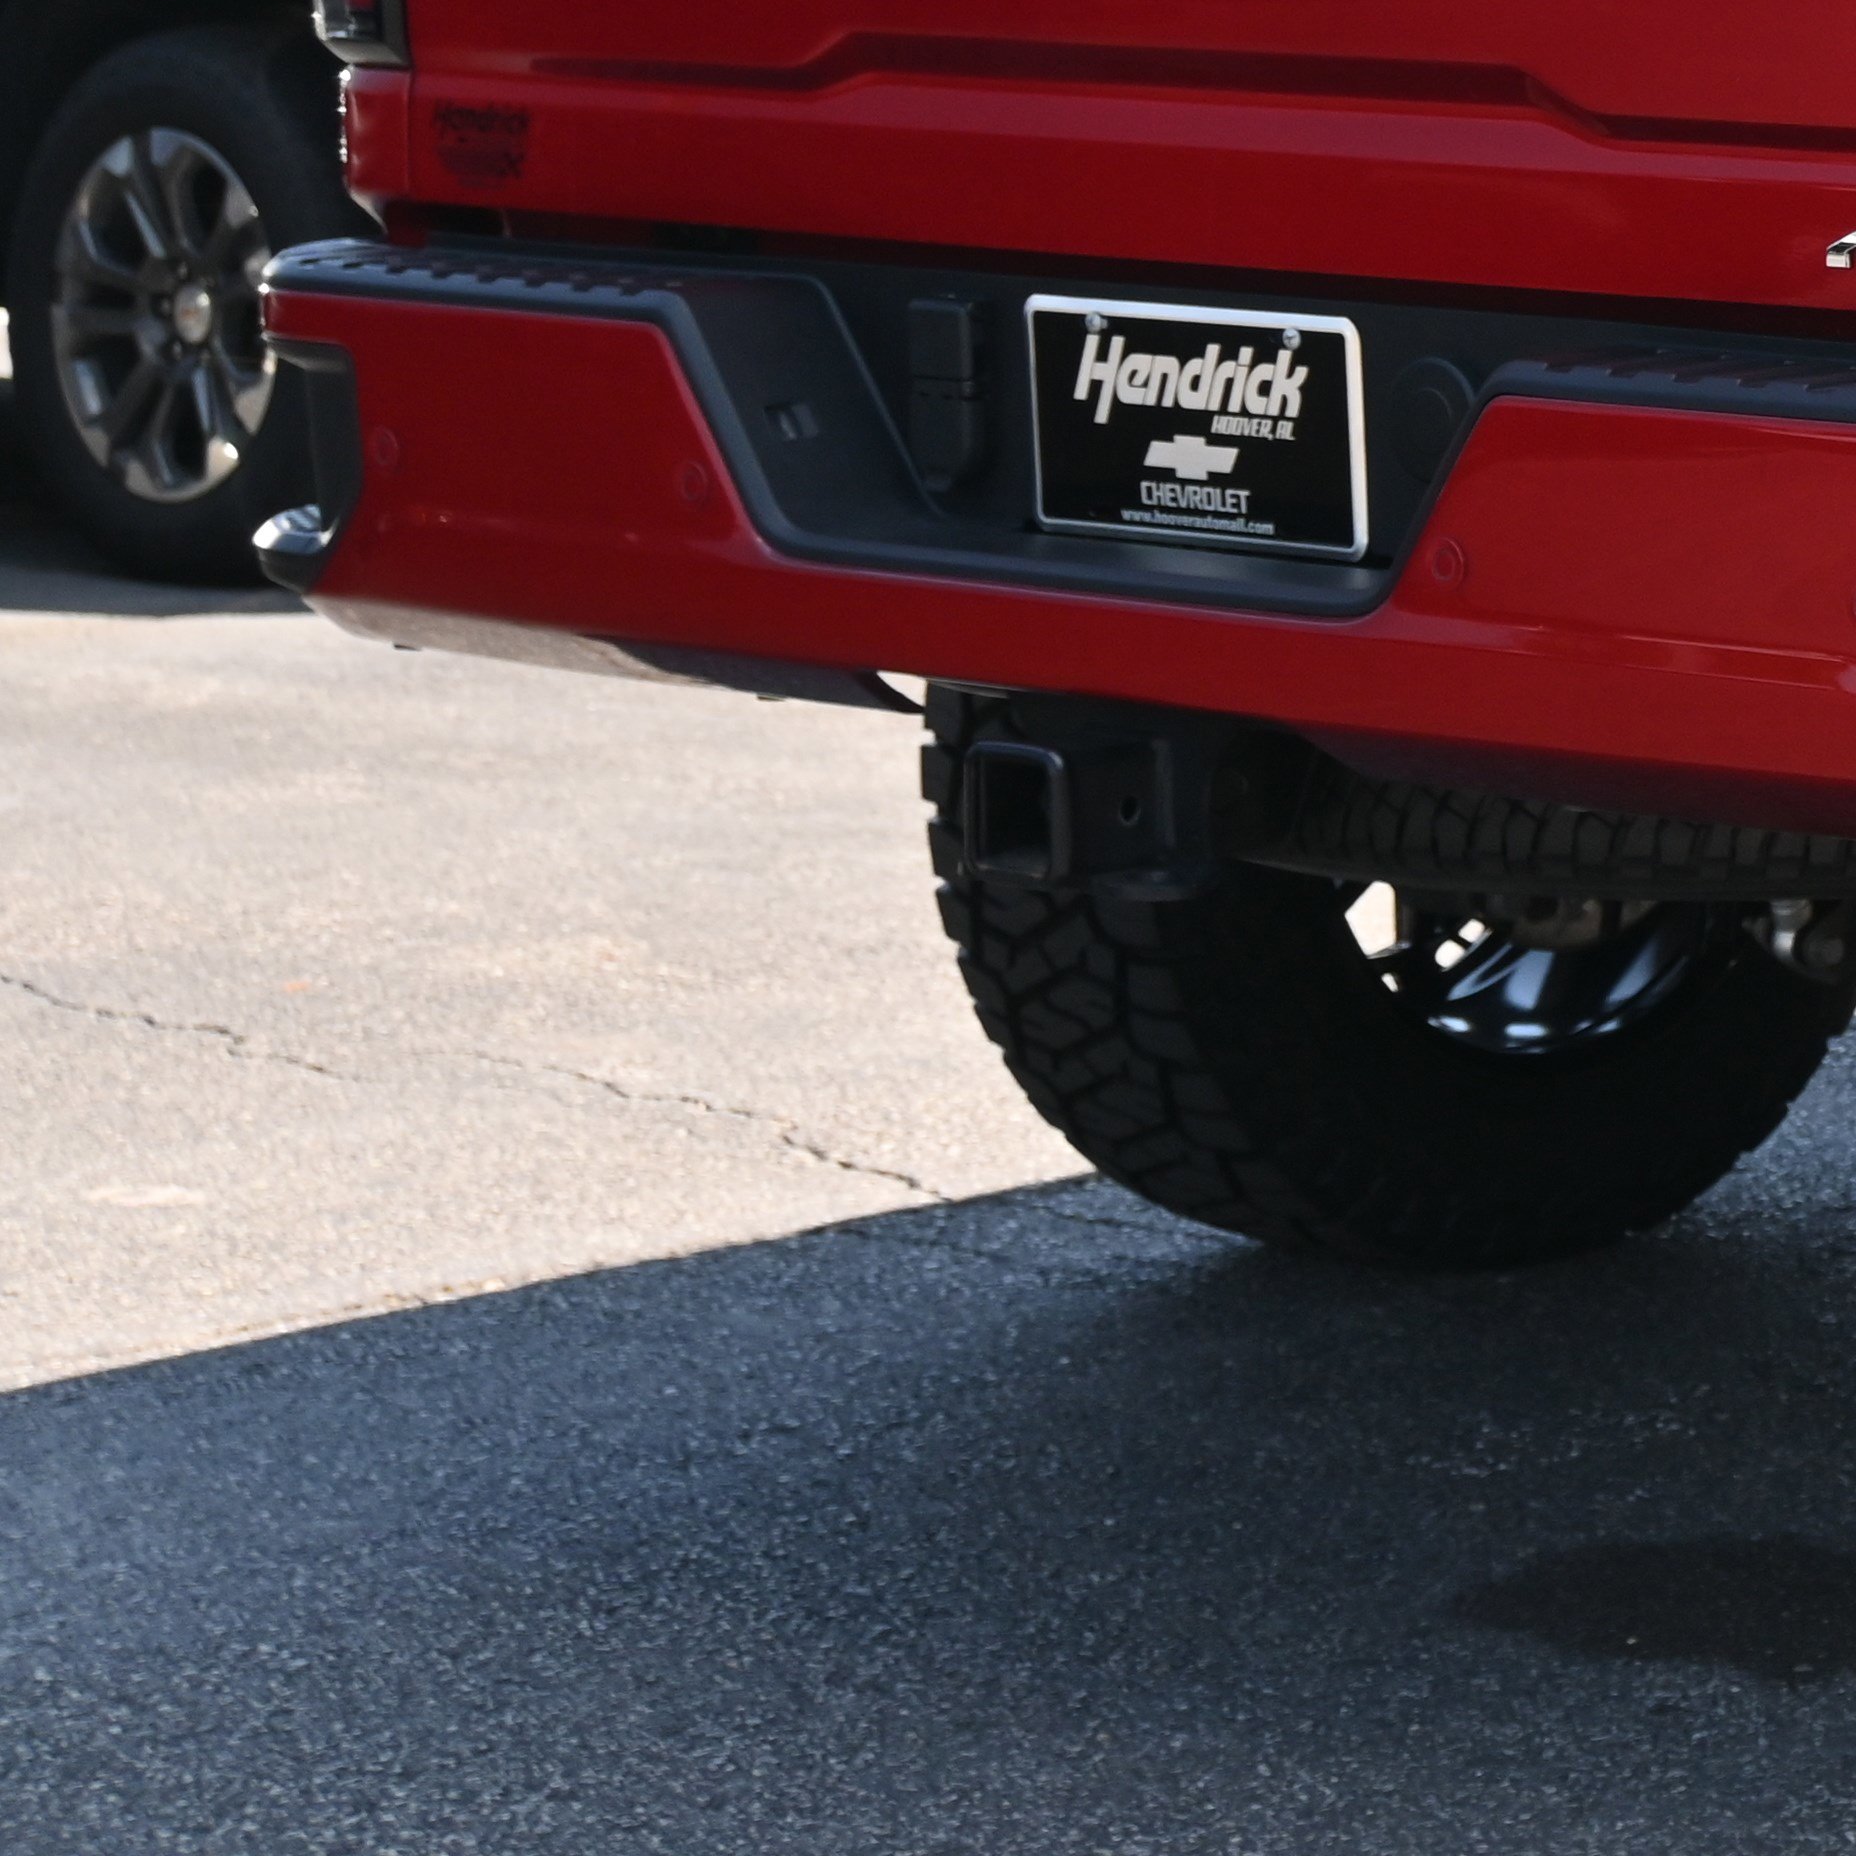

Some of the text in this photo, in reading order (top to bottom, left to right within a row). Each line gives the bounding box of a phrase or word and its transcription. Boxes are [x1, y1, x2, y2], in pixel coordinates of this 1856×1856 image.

[1073, 333, 1309, 425] Hendrick
[1210, 415, 1274, 441] HOOVER,
[1140, 479, 1251, 515] CHEVROLET
